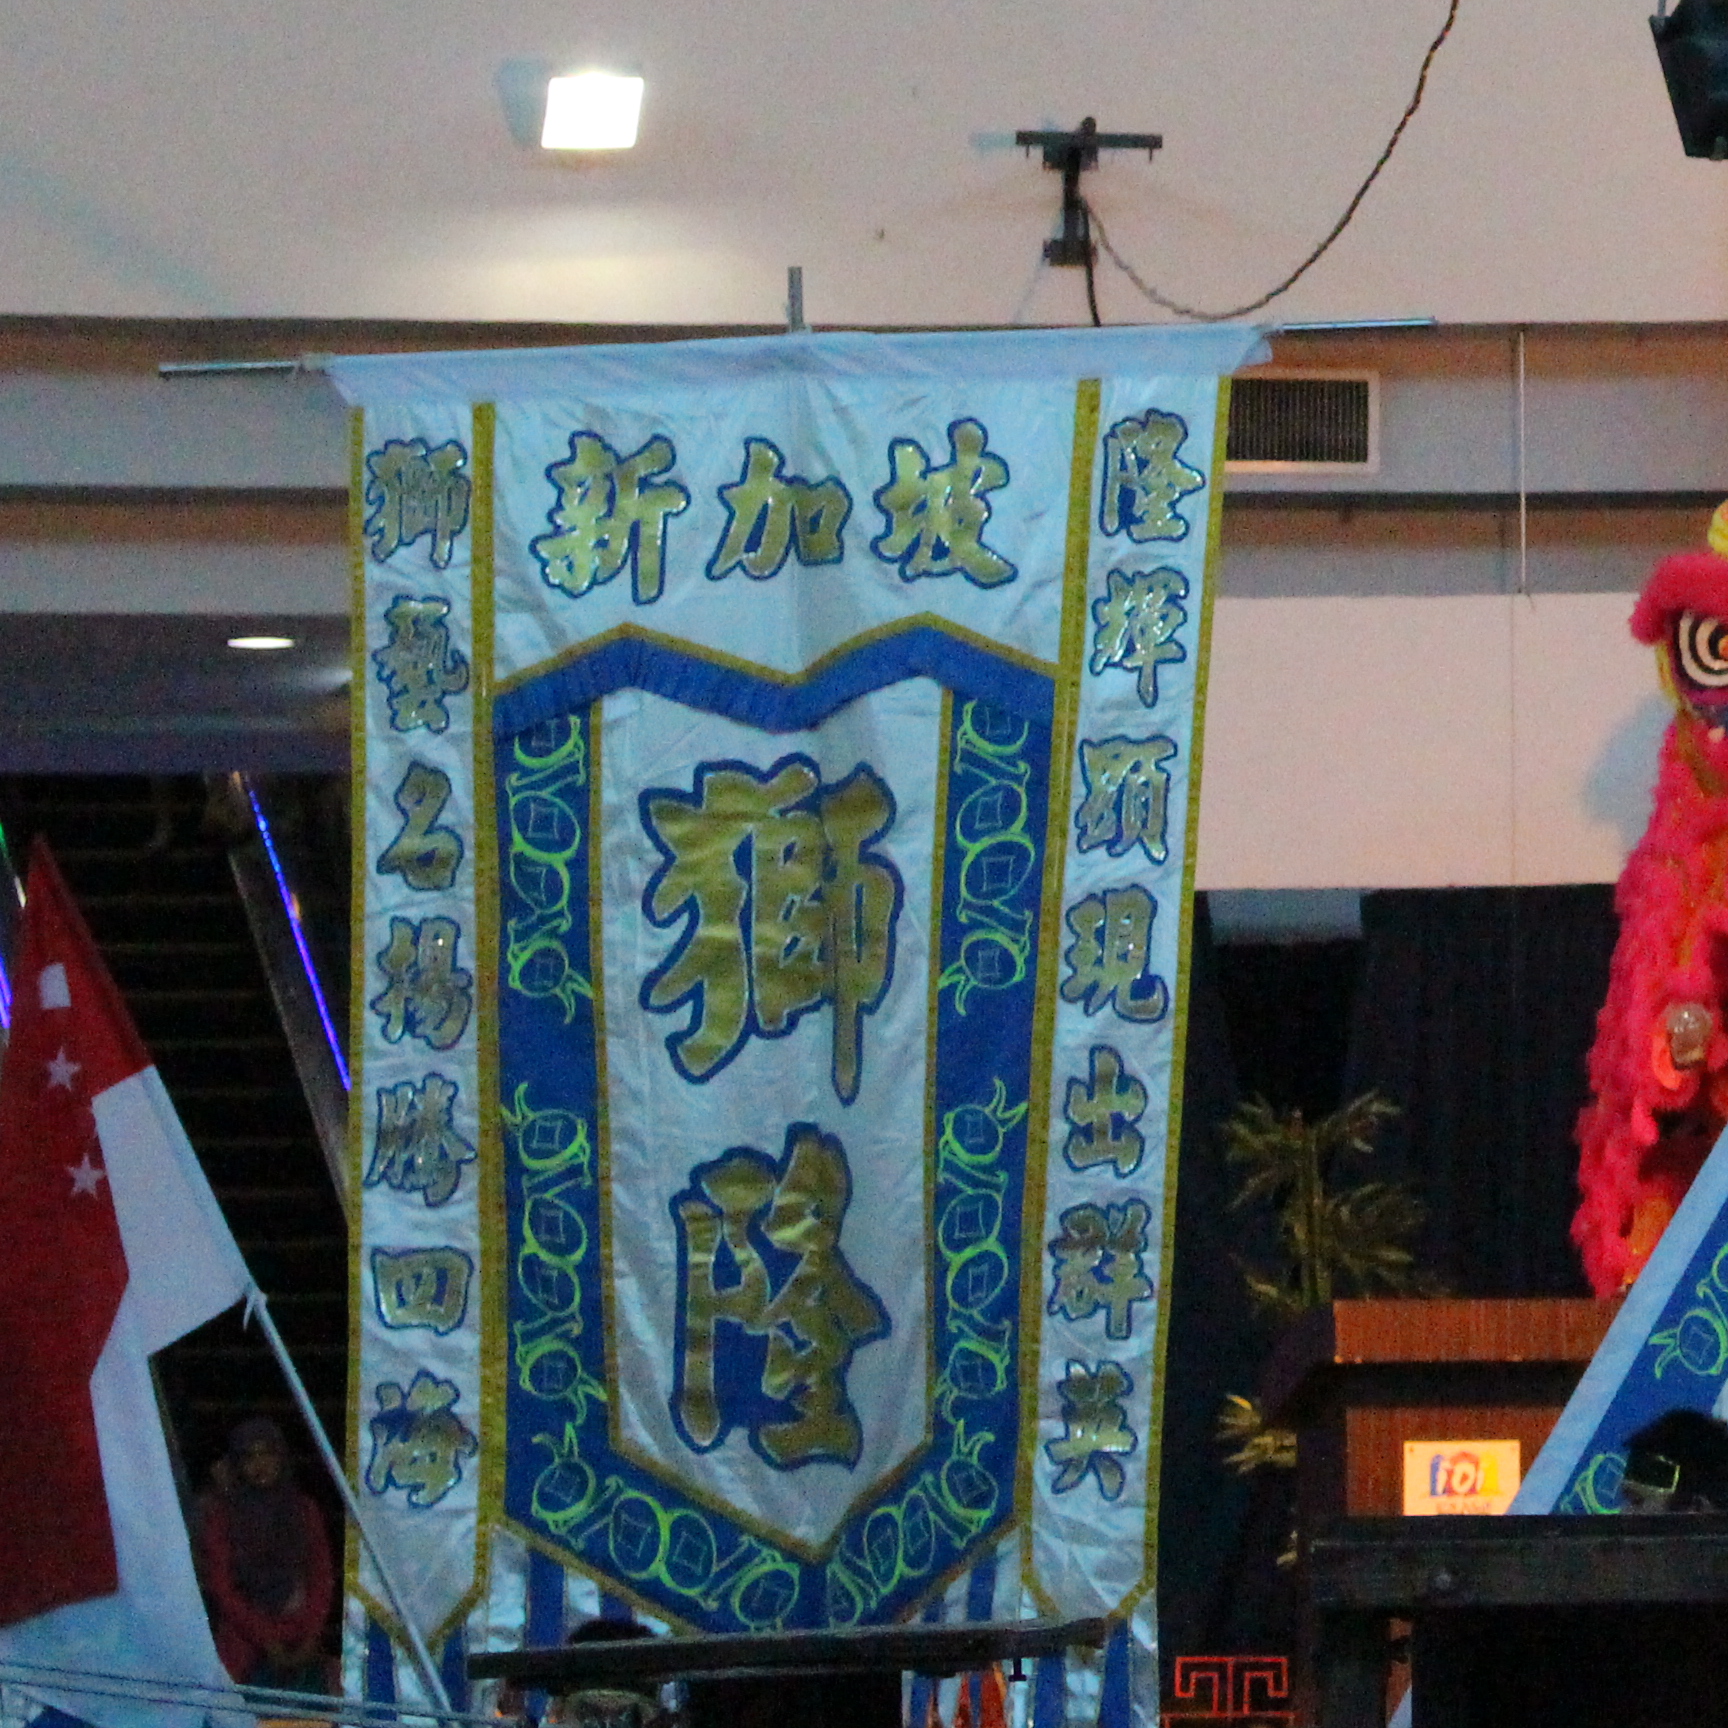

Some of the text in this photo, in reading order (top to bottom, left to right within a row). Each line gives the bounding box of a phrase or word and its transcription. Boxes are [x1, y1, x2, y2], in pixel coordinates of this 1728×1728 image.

[529, 417, 1019, 605] 新加坡
[638, 752, 904, 1472] 獅隆
